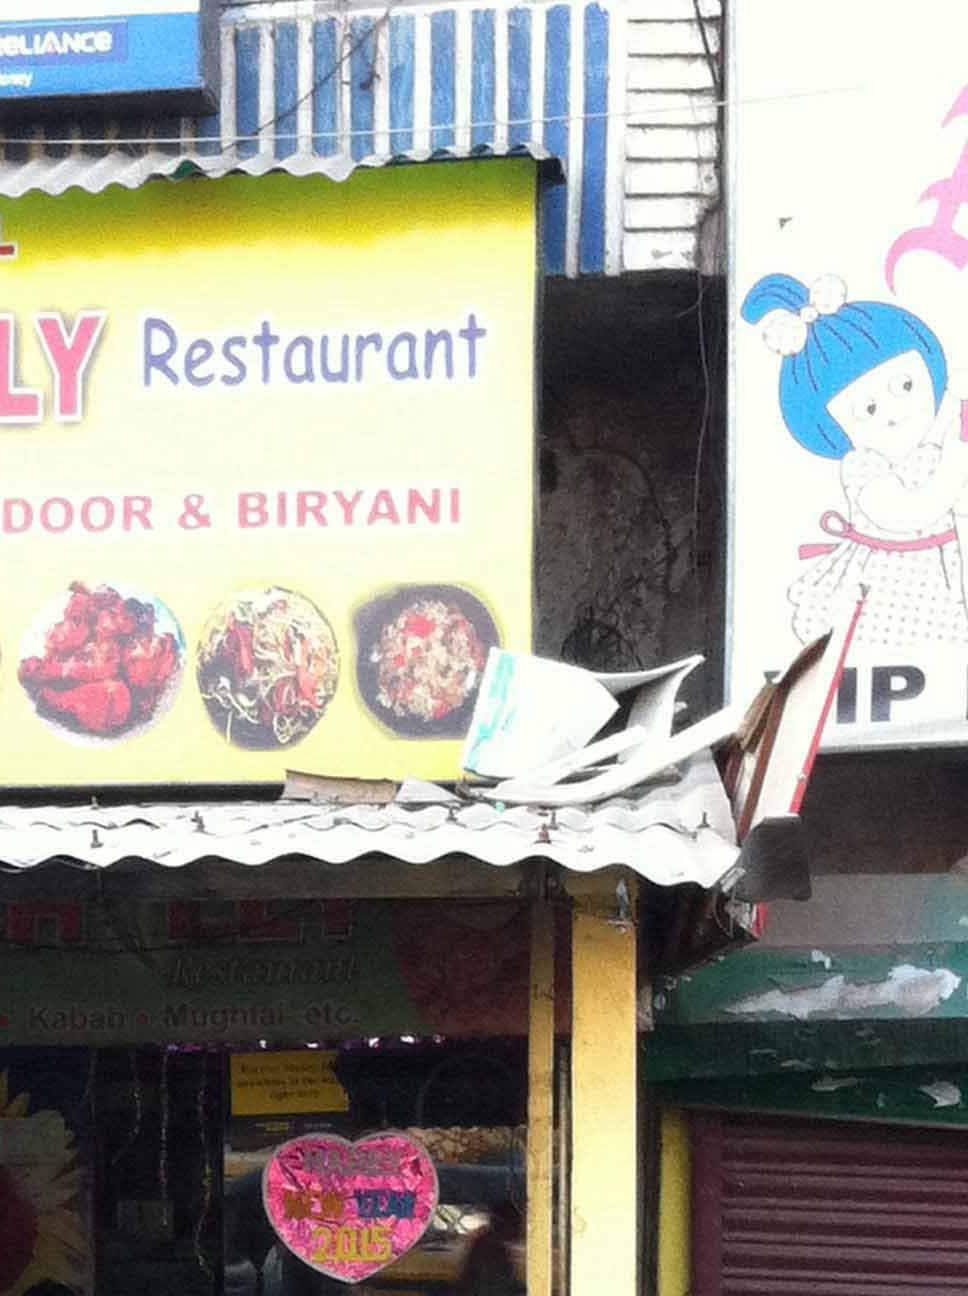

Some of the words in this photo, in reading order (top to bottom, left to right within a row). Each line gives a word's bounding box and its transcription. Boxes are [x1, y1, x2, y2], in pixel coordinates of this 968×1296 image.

[143, 313, 487, 388] Restaurant
[178, 494, 212, 530] &
[237, 488, 461, 530] BIRYANI
